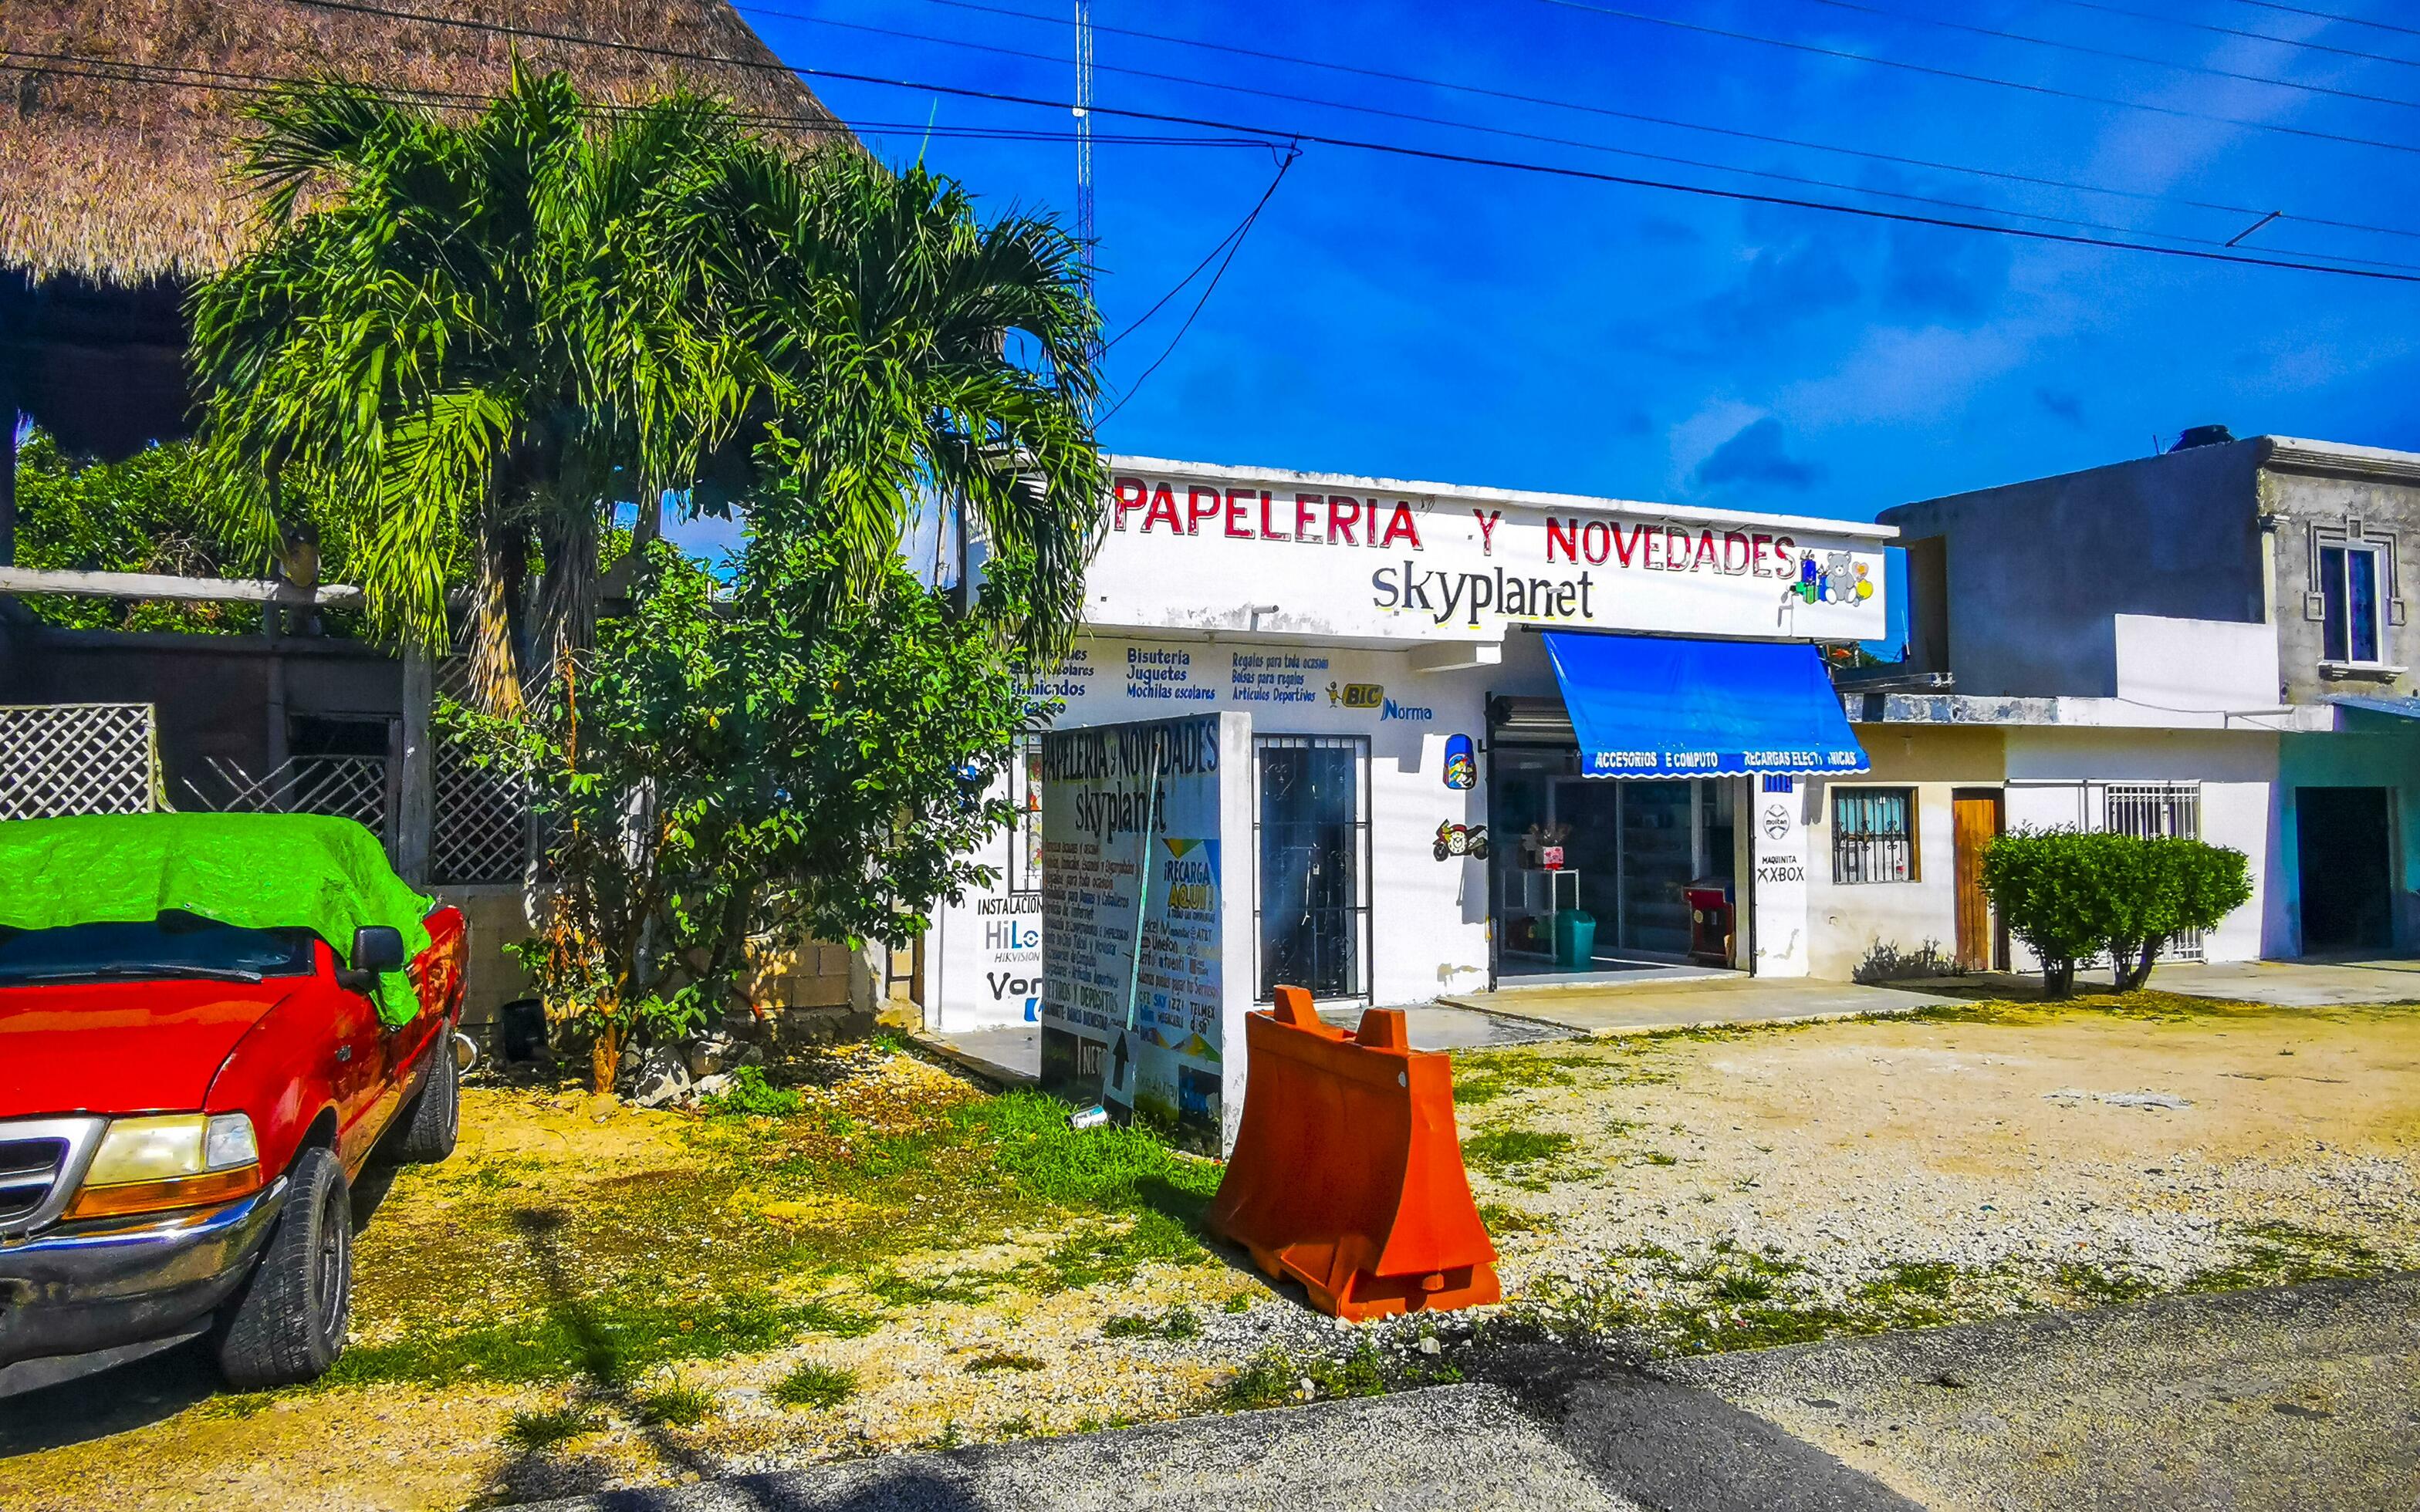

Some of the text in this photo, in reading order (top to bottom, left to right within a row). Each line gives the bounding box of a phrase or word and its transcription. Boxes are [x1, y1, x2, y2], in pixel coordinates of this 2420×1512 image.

[1114, 476, 1796, 580] PAPELERIA Y NOVEDADES
[1232, 652, 1264, 670] Regalos
[1126, 664, 1188, 685] Juguetes
[1232, 669, 1304, 688] Bolsas para regalos
[1127, 682, 1215, 700] Mochilas escolares
[1381, 697, 1433, 721] Norma
[1118, 721, 1219, 778] NOVEDADES
[1742, 751, 1790, 766] RECARGAS
[1595, 751, 1658, 768] ACCESORIOS
[1674, 752, 1718, 768] COMPUTO
[1763, 856, 1797, 865] MAQUINITA
[1769, 866, 1804, 882] XBOX
[995, 951, 1040, 964] HIKVISION
